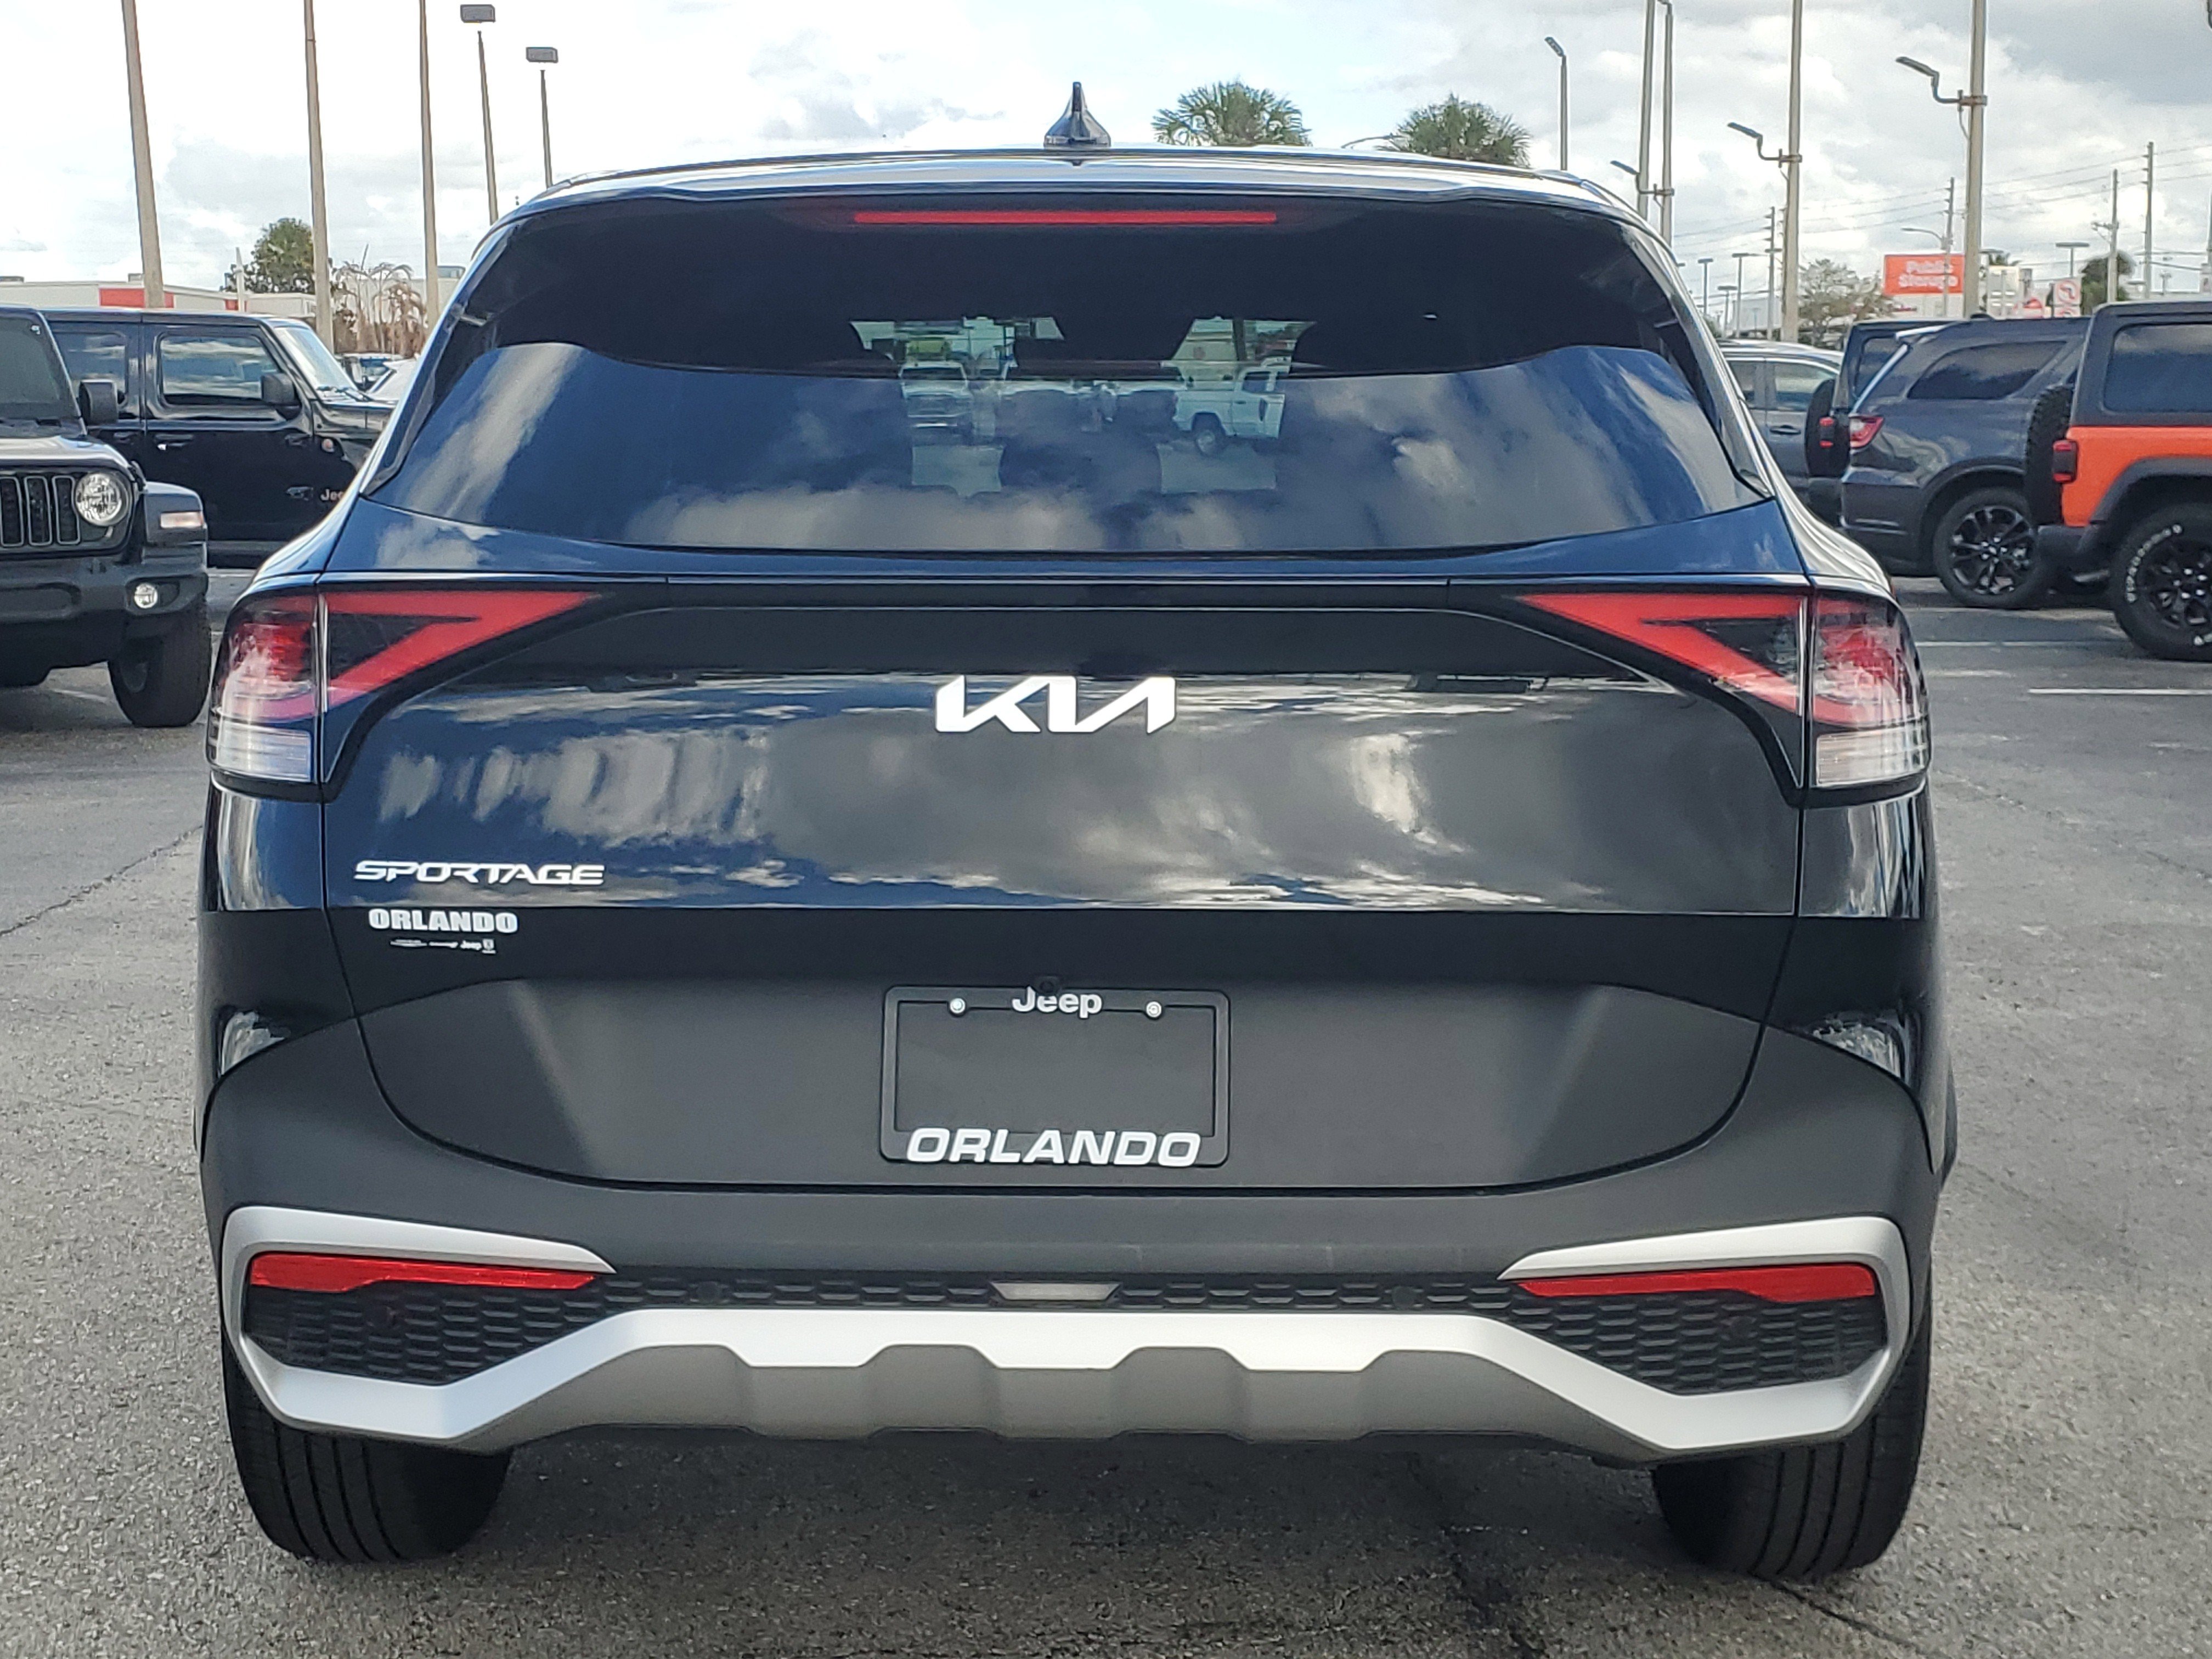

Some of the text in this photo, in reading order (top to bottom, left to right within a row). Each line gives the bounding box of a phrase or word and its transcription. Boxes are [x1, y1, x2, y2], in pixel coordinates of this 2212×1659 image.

[935, 675, 1176, 734] KIA
[354, 860, 605, 885] SPORTAGE
[368, 908, 518, 933] ORLANDO
[1012, 986, 1102, 1019] Jeep
[906, 1127, 1201, 1167] ORLANDO
